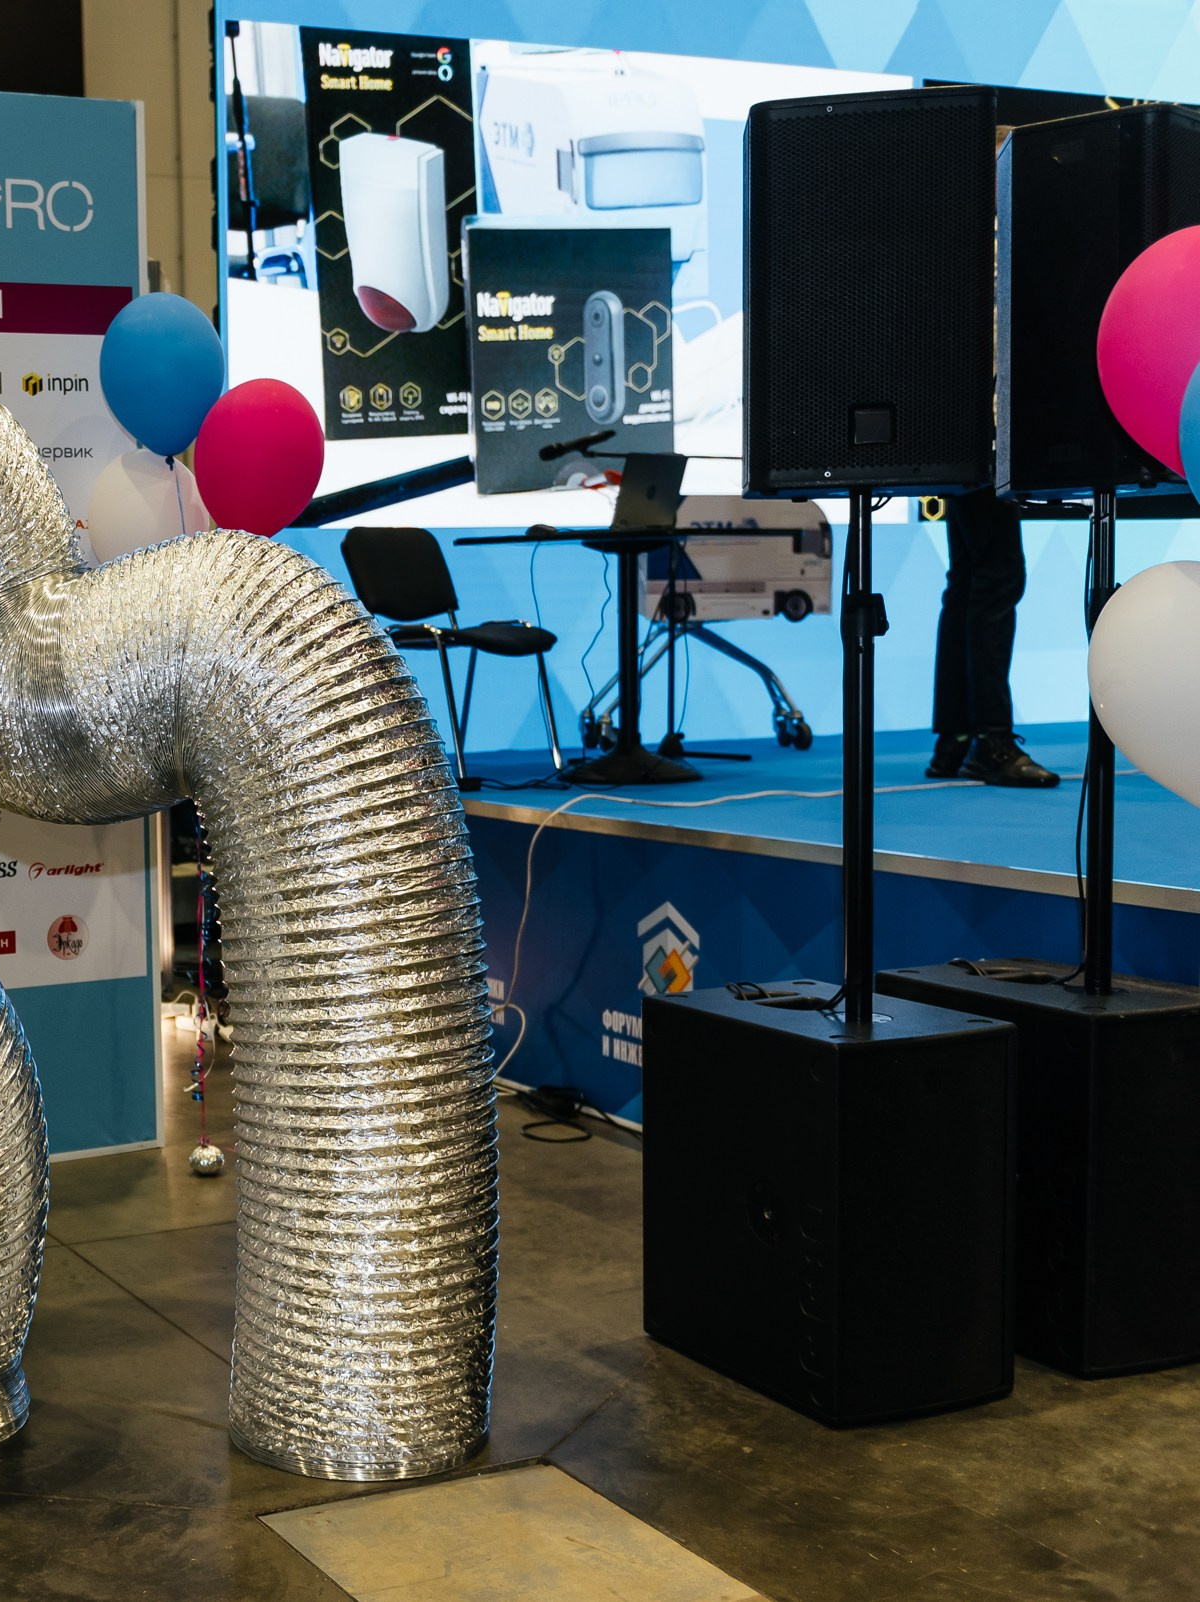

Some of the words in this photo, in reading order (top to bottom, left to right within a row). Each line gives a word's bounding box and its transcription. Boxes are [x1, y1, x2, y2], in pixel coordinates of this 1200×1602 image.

[318, 43, 394, 72] Navigator
[320, 74, 358, 90] Smart
[359, 75, 393, 91] Home
[476, 290, 555, 322] Navigator
[478, 325, 517, 341] Smart
[518, 324, 554, 340] Home
[47, 374, 89, 395] inpin
[46, 863, 103, 877] arlight
